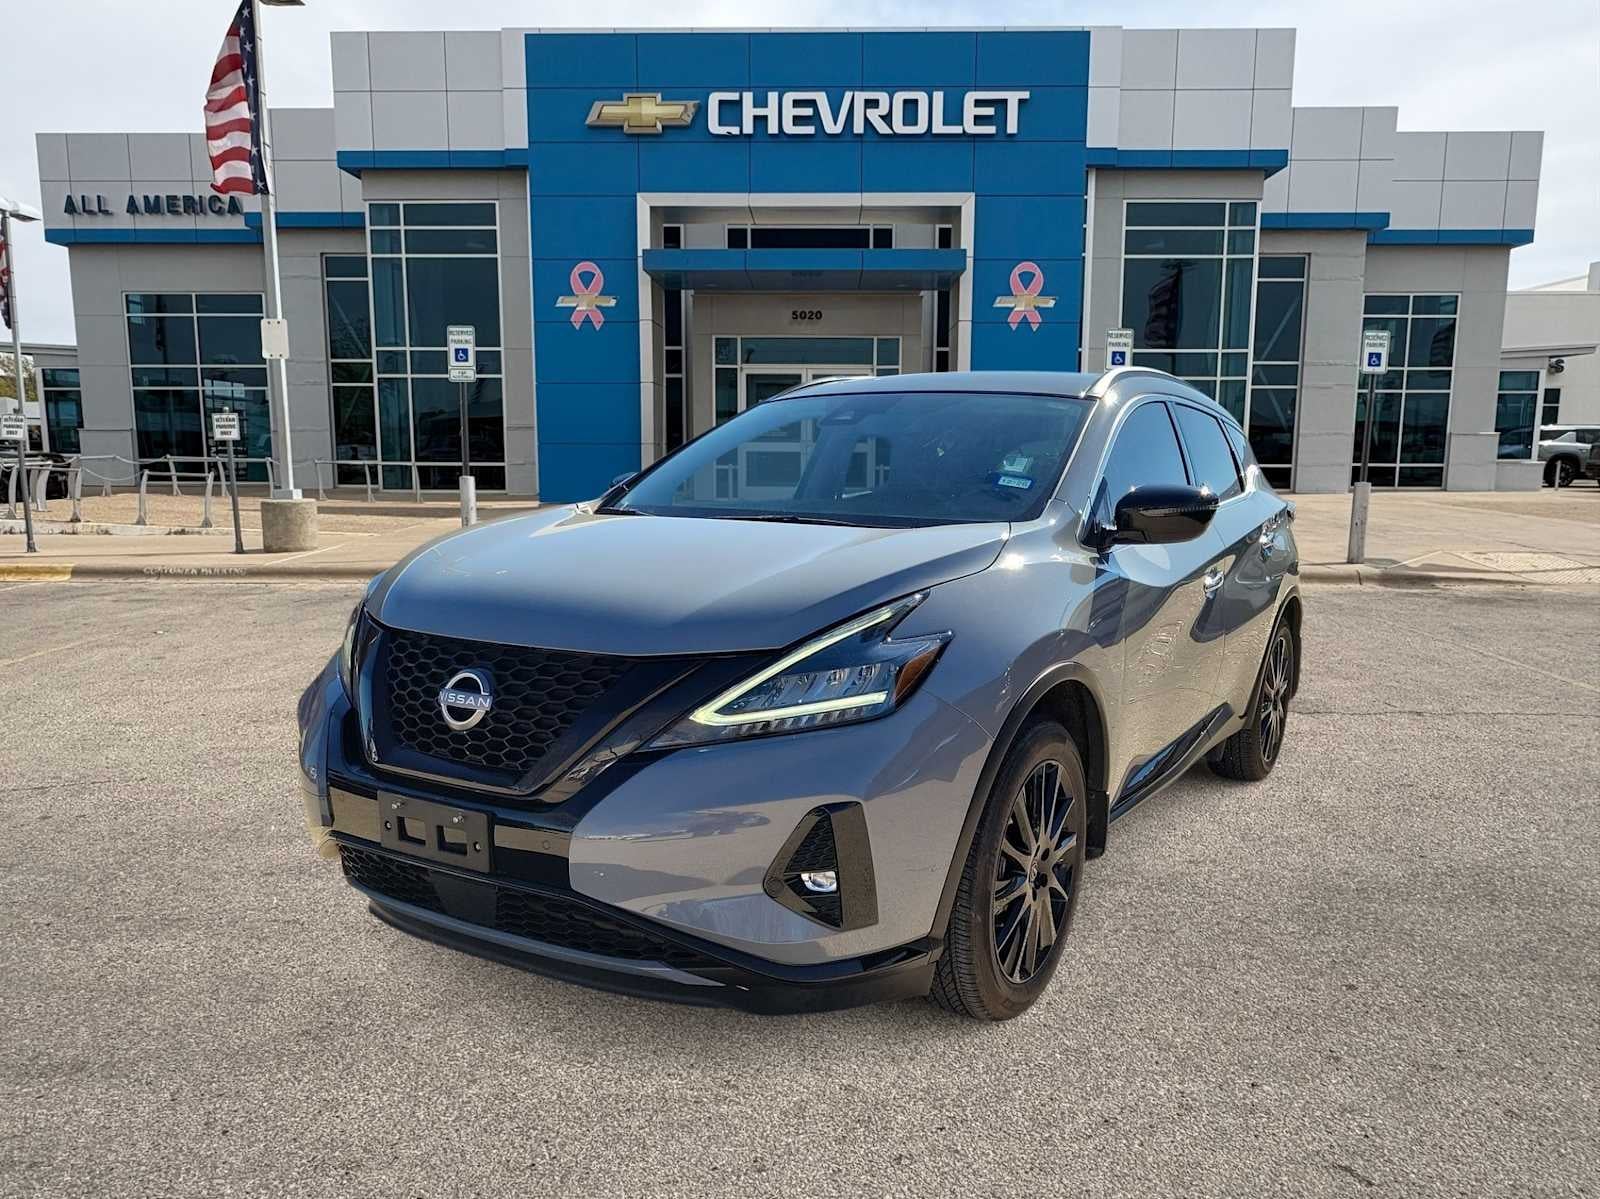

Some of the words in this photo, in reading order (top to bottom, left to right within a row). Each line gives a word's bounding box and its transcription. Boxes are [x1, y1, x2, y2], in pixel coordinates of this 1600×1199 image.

[707, 91, 1030, 136] CHEVROLET
[64, 194, 113, 215] ALL
[126, 194, 243, 215] AMERICA
[791, 310, 823, 320] 5020
[440, 690, 490, 708] NISSAN
